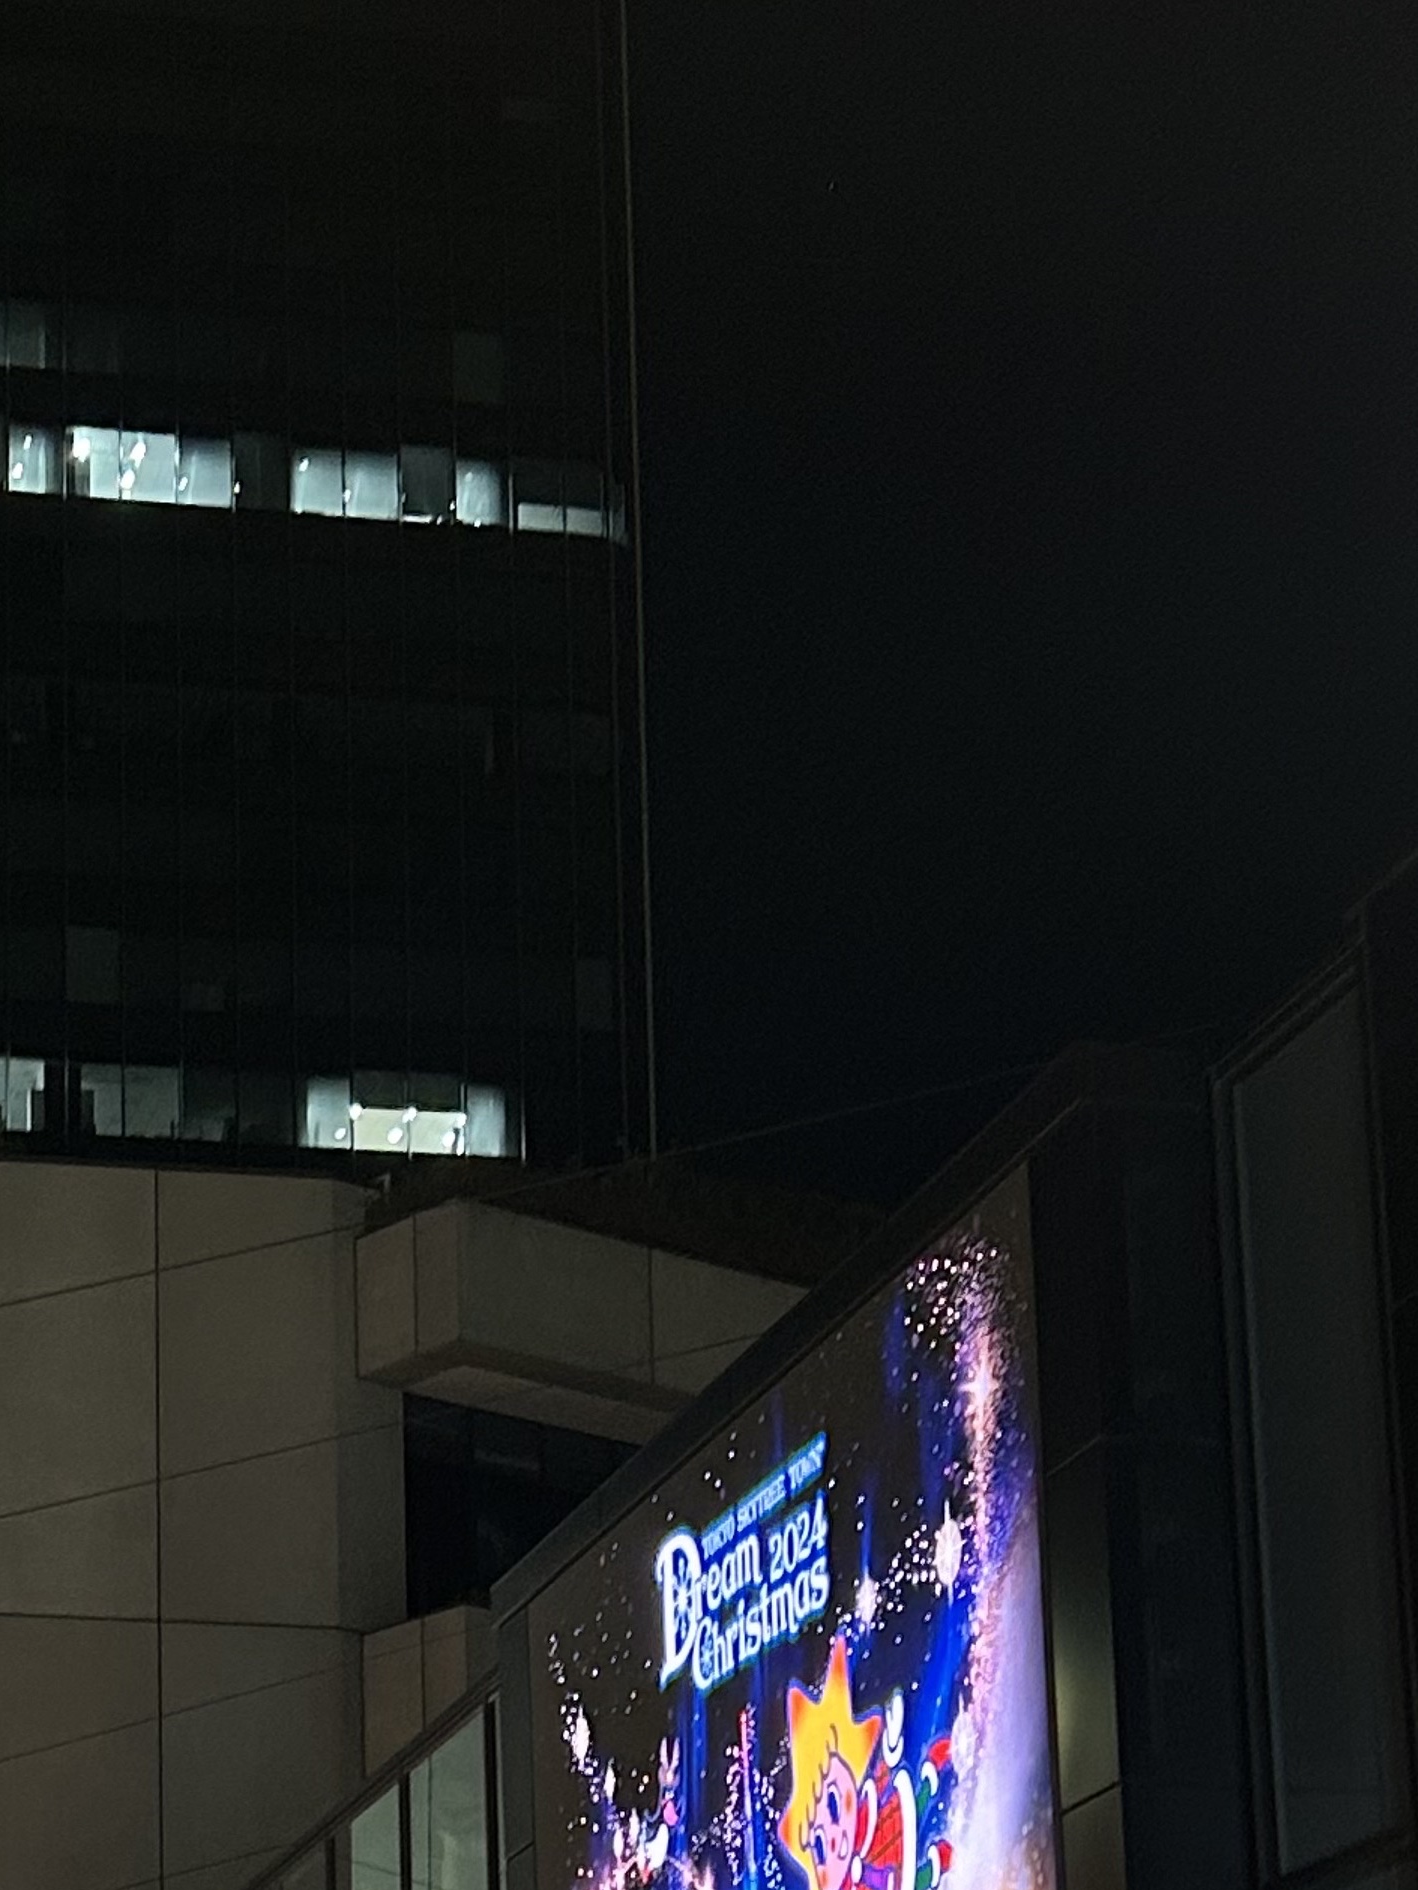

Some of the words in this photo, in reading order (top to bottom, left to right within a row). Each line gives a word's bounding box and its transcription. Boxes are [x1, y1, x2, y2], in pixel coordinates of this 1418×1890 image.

[656, 1533, 762, 1680] Dream
[768, 1497, 828, 1583] 2024
[692, 1556, 829, 1689] Christmas
